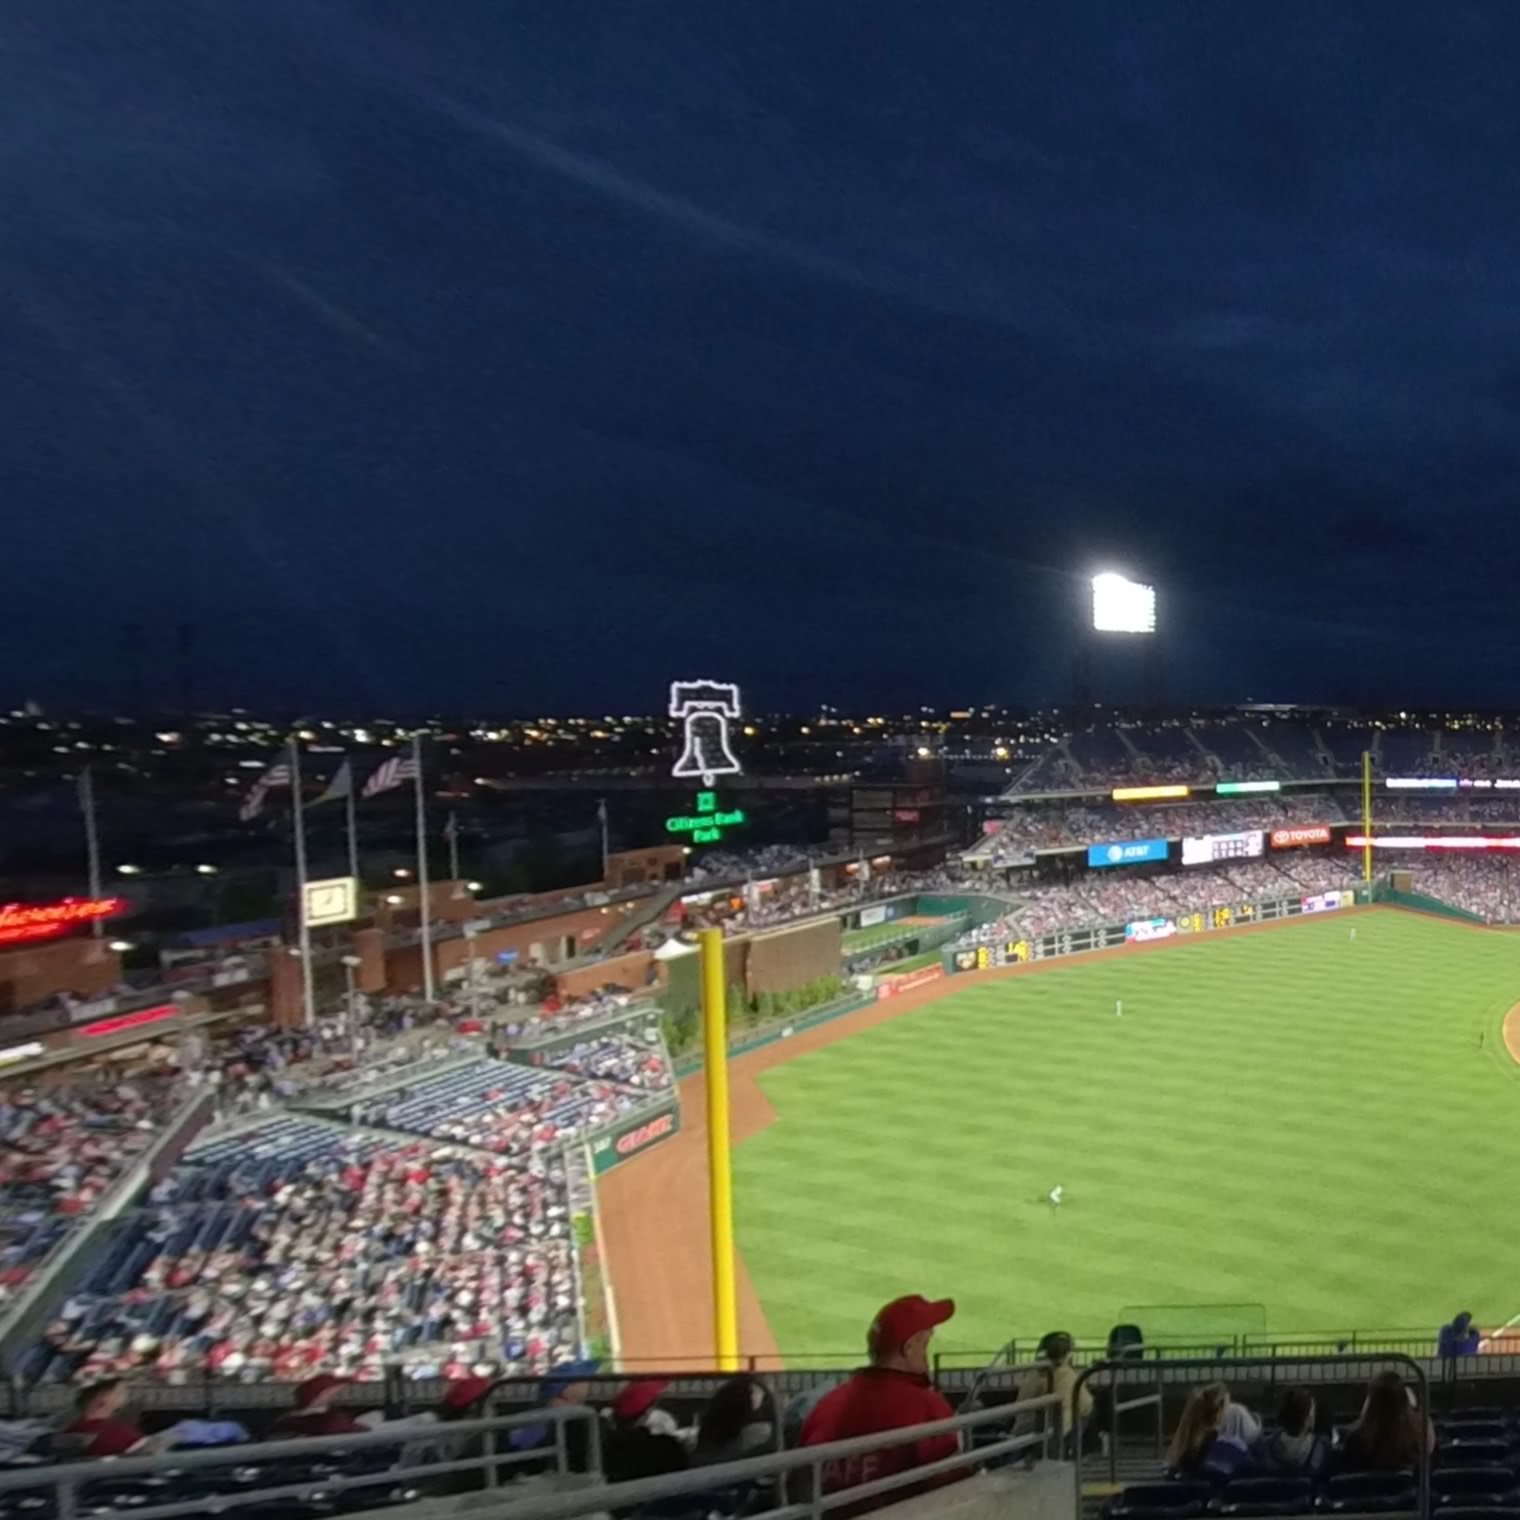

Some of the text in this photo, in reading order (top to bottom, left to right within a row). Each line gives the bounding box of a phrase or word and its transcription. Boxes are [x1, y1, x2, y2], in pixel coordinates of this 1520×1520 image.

[667, 810, 743, 831] Citizens Bank
[694, 828, 719, 842] Park
[1289, 828, 1328, 840] TOYOTA
[1124, 845, 1150, 857] AT&T
[617, 1115, 673, 1152] GIANT
